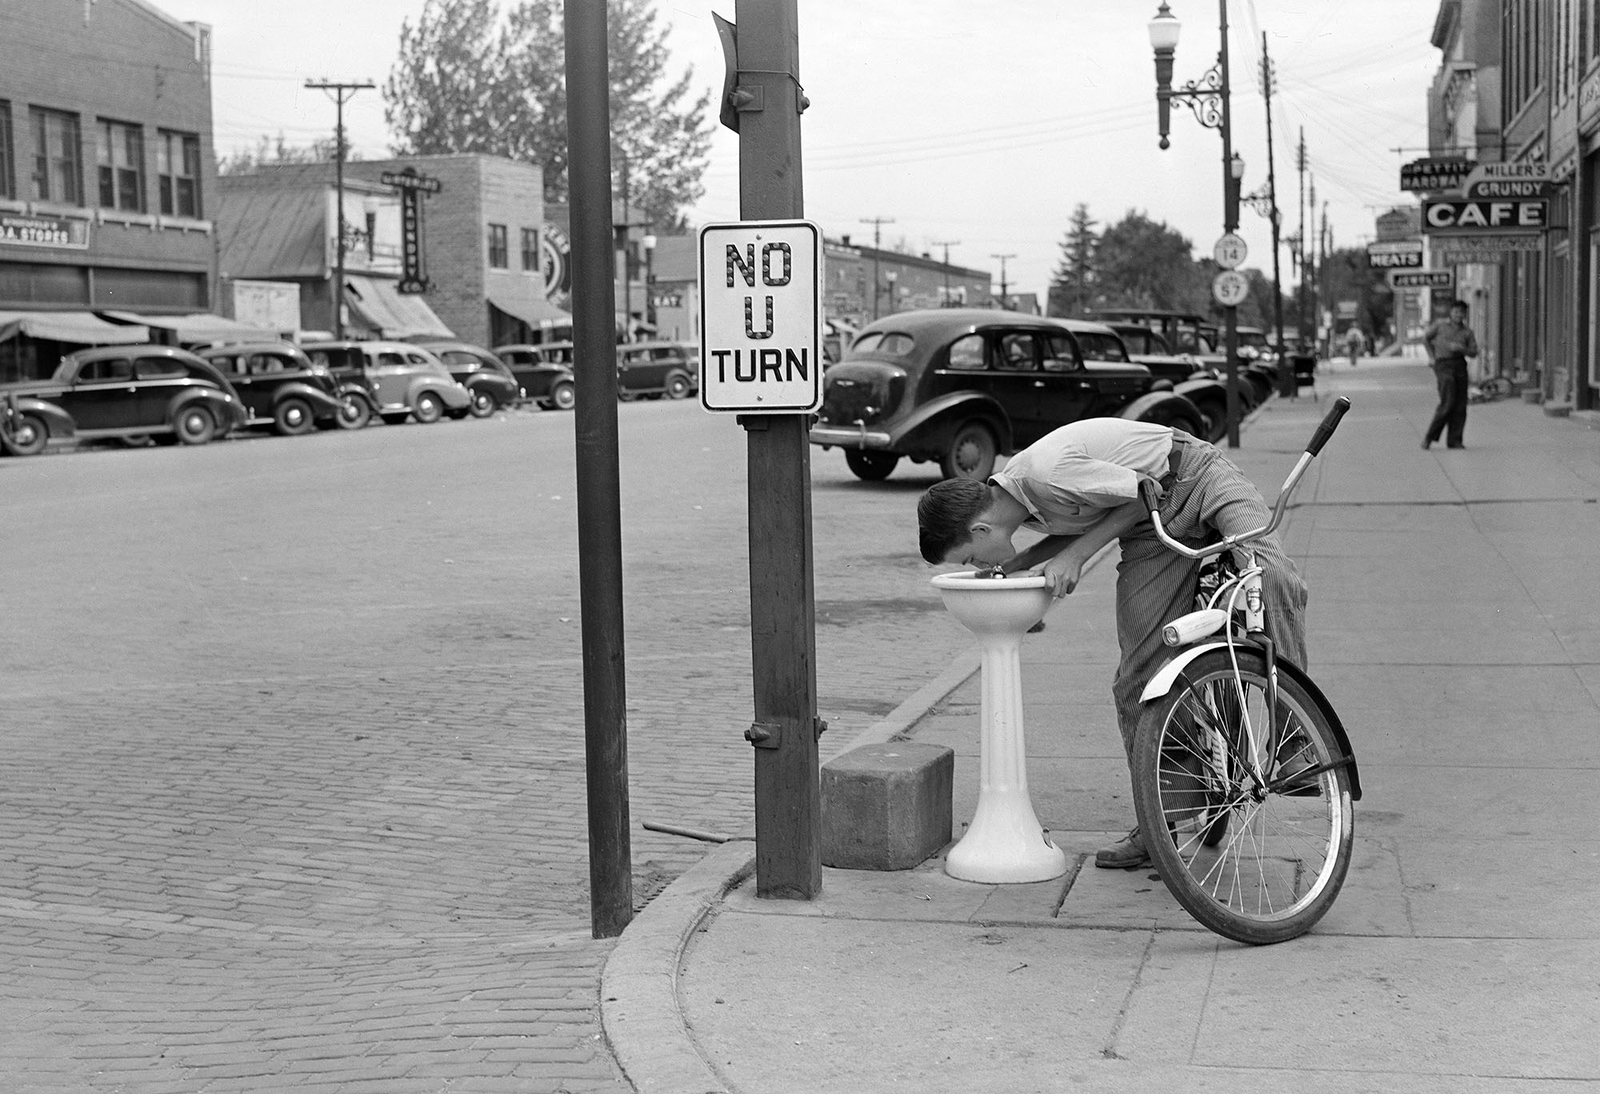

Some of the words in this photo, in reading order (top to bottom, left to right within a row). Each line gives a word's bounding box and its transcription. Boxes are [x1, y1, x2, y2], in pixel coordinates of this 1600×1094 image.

[1484, 164, 1546, 177] MILLER'S
[1402, 175, 1466, 189] HARDWAR
[1477, 182, 1544, 196] GRUNDY
[1427, 202, 1543, 227] CAFE
[20, 227, 68, 245] STORES
[404, 196, 417, 277] LAUNDRY
[1223, 249, 1238, 259] 14
[1370, 253, 1419, 267] MEATS
[726, 242, 791, 288] NO
[1221, 285, 1240, 298] 57
[653, 296, 679, 307] EAT
[744, 295, 774, 340] U
[711, 348, 808, 383] TURN
